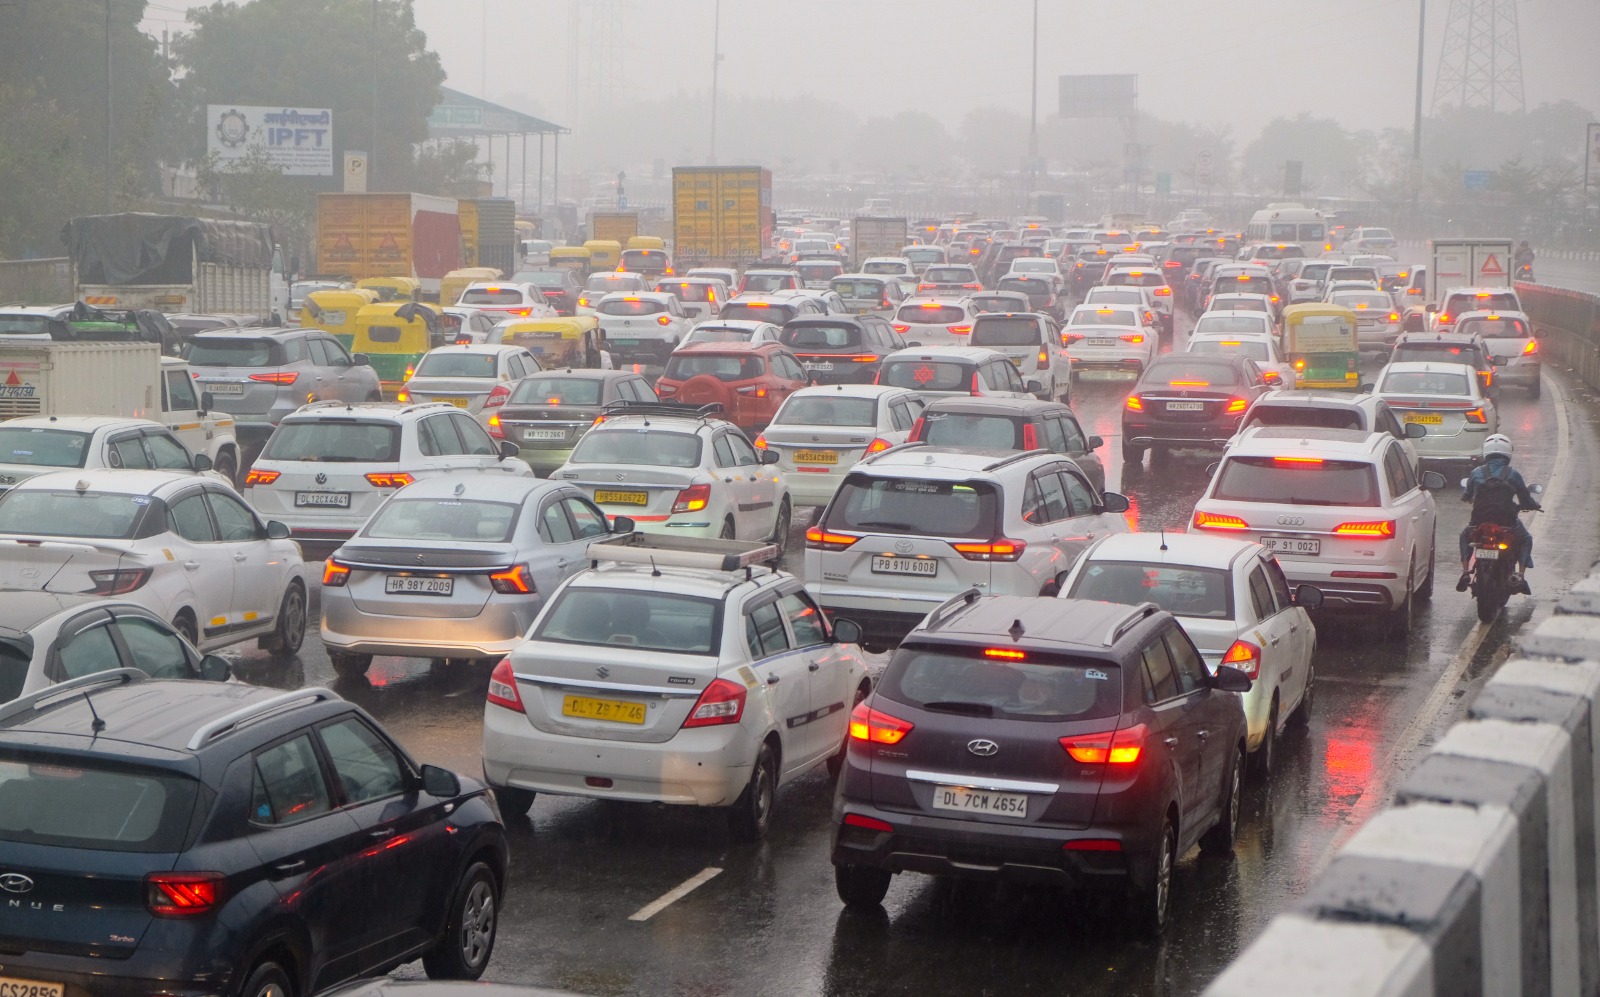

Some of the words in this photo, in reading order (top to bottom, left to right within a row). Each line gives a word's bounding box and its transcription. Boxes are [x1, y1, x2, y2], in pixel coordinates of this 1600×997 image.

[268, 128, 328, 147] IPFT
[678, 246, 709, 256] Blow
[726, 245, 755, 256] Horn
[301, 494, 348, 505] DL12CX4841
[1266, 540, 1277, 549] HP
[1282, 541, 1292, 550] 91
[1297, 542, 1318, 552] 0021
[879, 559, 890, 569] PB
[893, 560, 910, 571] 91U
[912, 562, 935, 573] 6008
[393, 579, 404, 590] HR
[407, 580, 425, 590] 98Y
[427, 581, 451, 591] 2009
[943, 791, 959, 807] DL
[964, 793, 989, 809] 7CM
[992, 796, 1025, 813] 4654
[110, 934, 135, 943] Turbo
